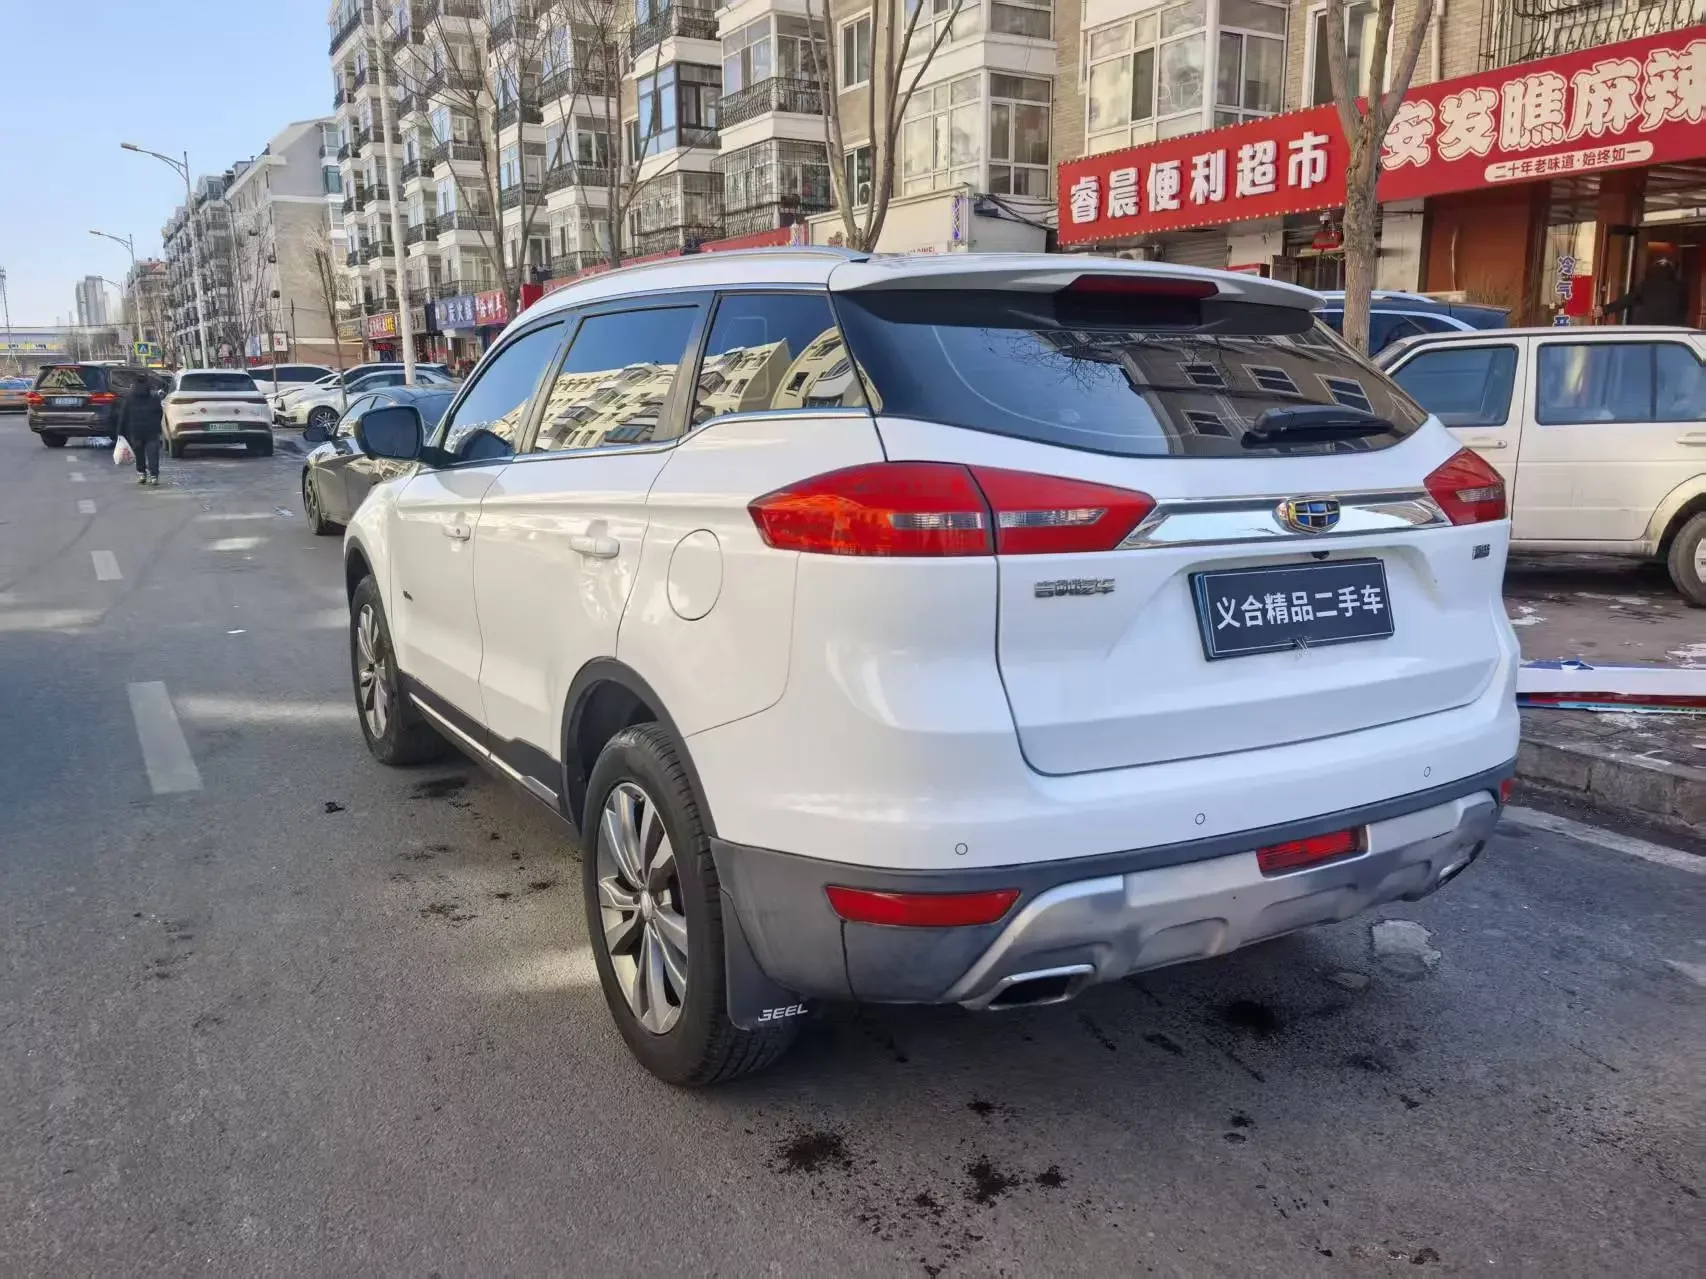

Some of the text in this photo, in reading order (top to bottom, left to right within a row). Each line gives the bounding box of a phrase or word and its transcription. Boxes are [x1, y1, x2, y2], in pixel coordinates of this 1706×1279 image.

[1069, 130, 1330, 224] 睿晨便利超市
[1216, 584, 1385, 630] 义合精品二手车
